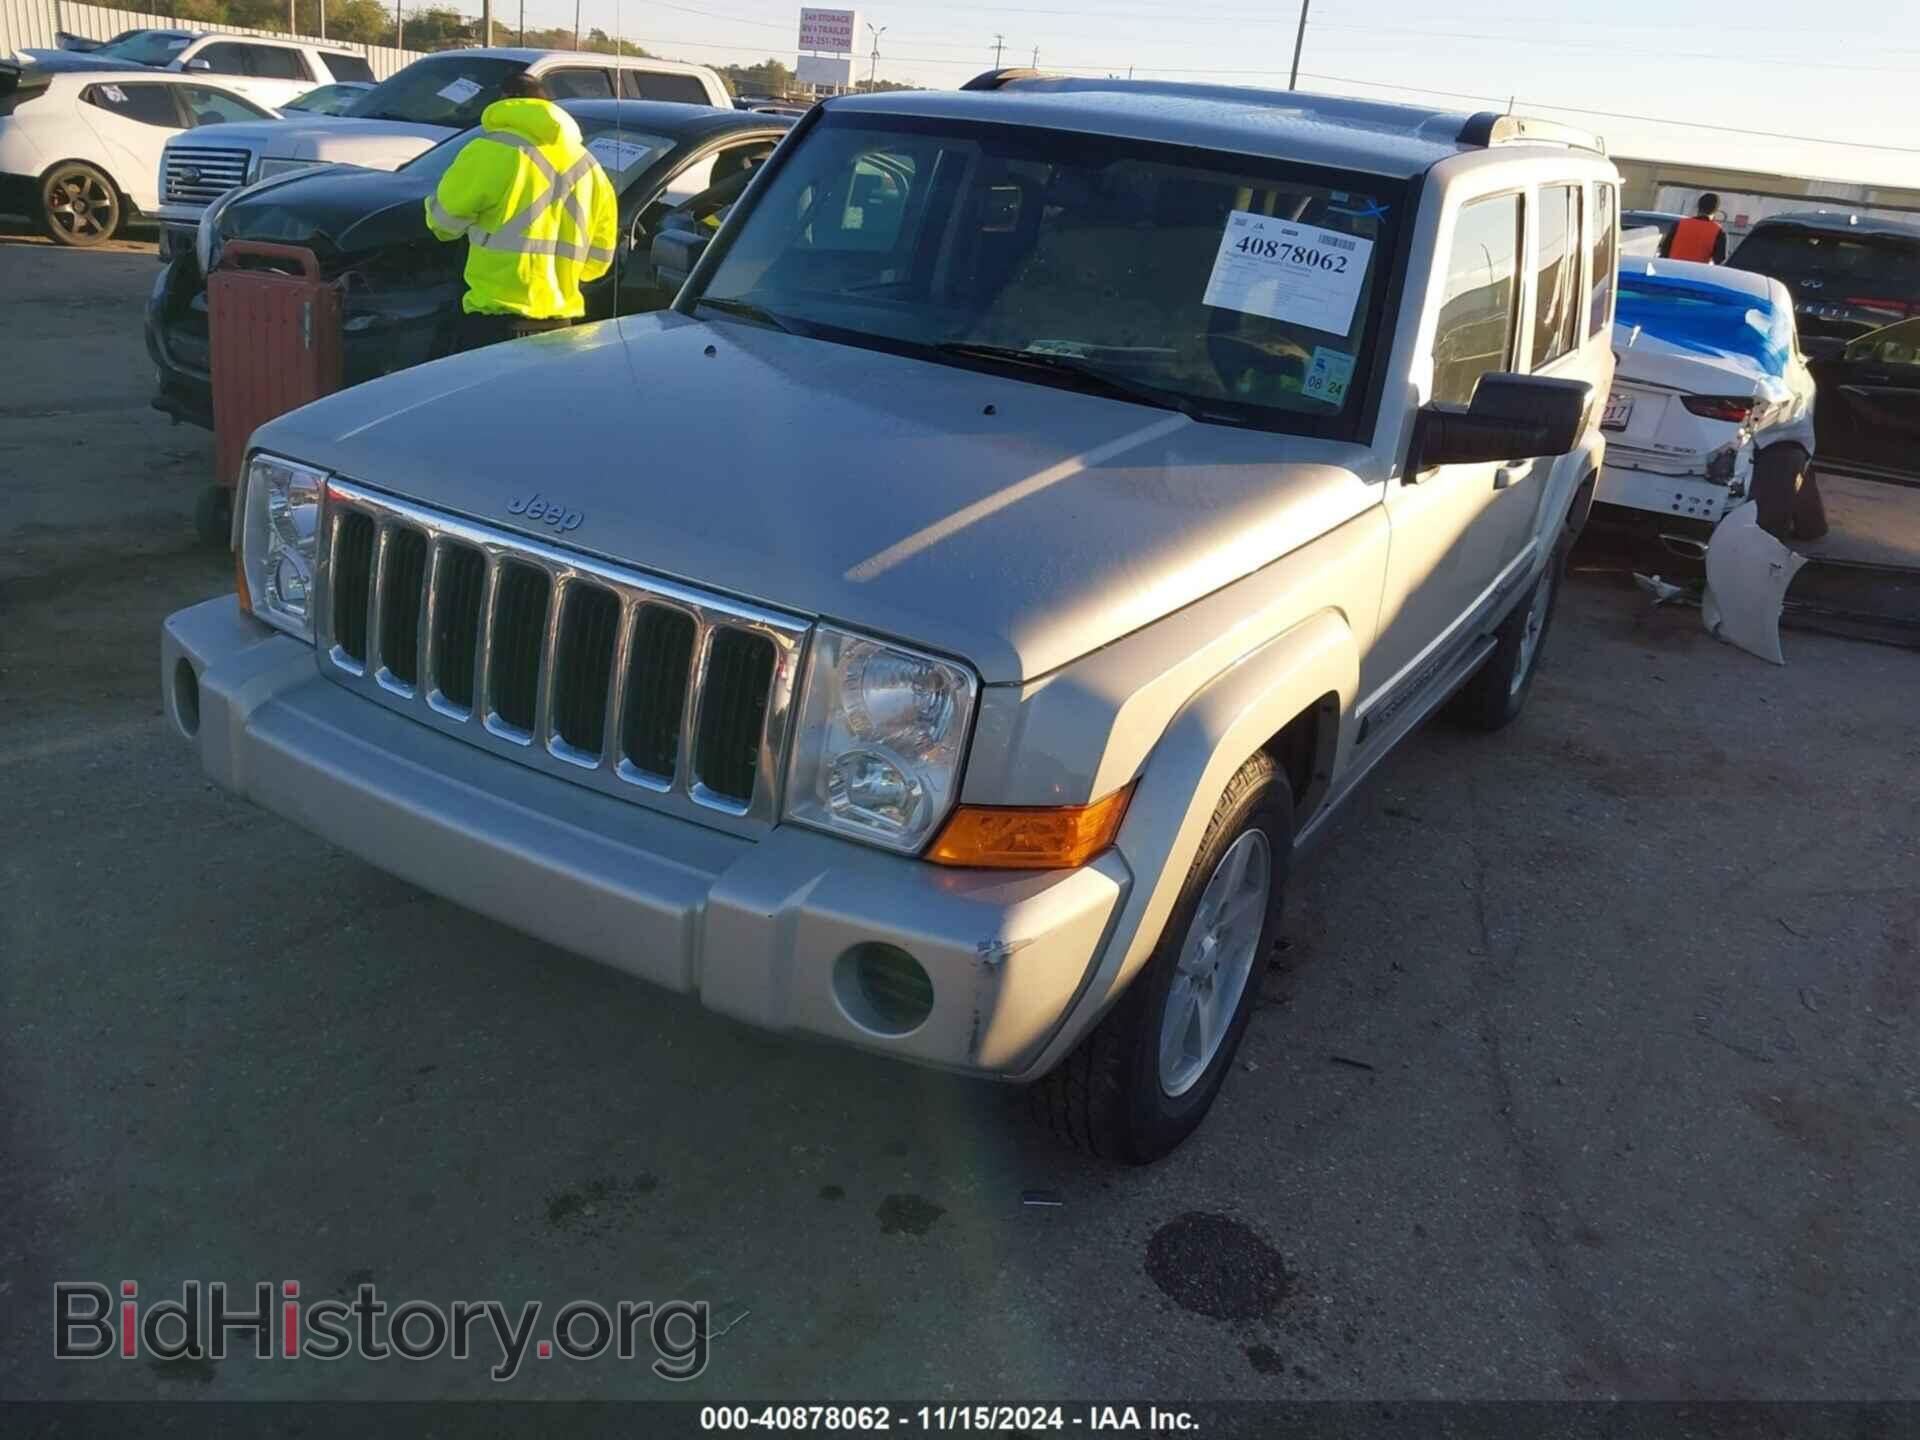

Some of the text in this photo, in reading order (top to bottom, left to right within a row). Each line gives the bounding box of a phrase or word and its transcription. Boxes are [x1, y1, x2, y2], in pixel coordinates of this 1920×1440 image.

[1235, 235, 1348, 274] 40878062
[1307, 375, 1322, 390] 08
[1327, 381, 1343, 395] 24
[505, 493, 585, 534] Jeep
